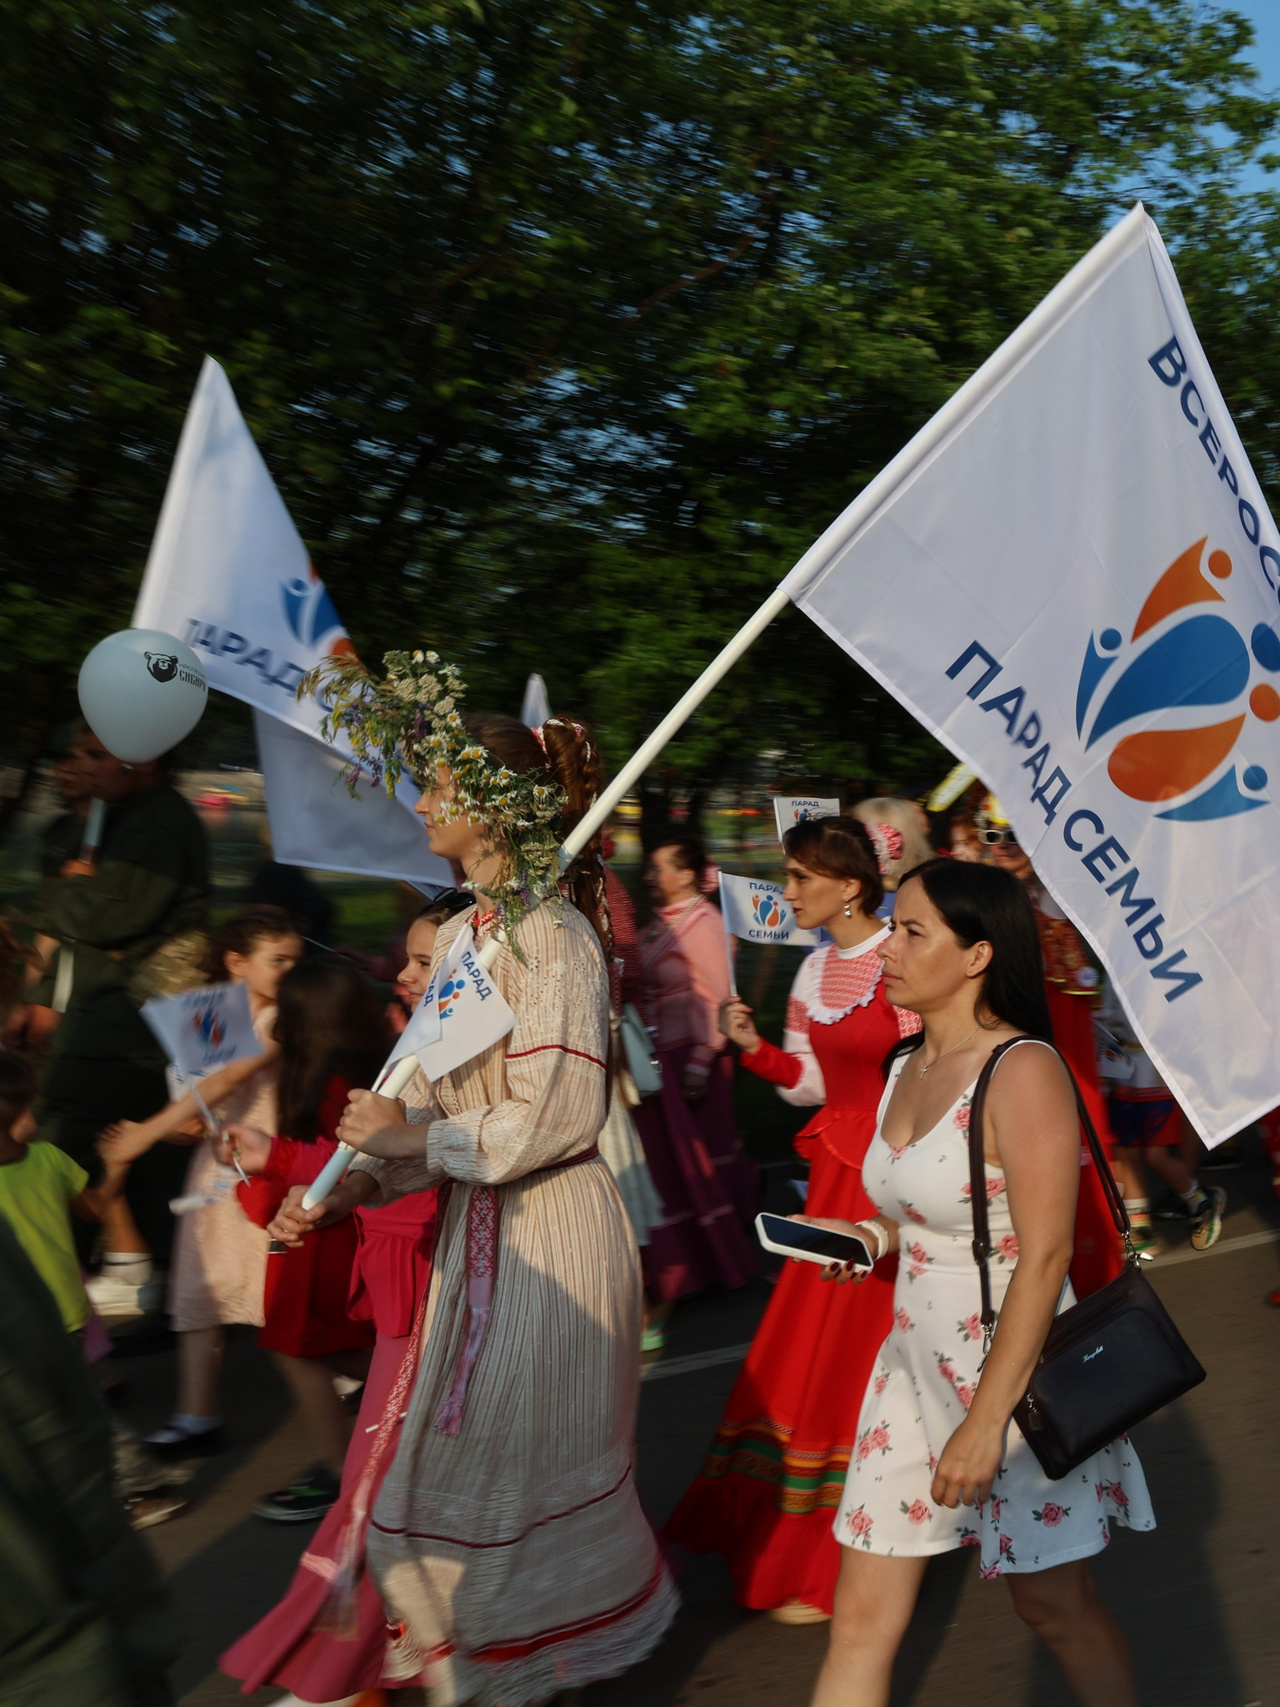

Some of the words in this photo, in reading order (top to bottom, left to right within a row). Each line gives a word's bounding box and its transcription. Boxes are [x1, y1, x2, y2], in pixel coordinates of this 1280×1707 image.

[945, 640, 1072, 825] ПАРАД
[1063, 809, 1204, 1004] СЕМЬИ
[748, 929, 790, 940] СЕМЬИ
[461, 951, 493, 1001] ПАРАД
